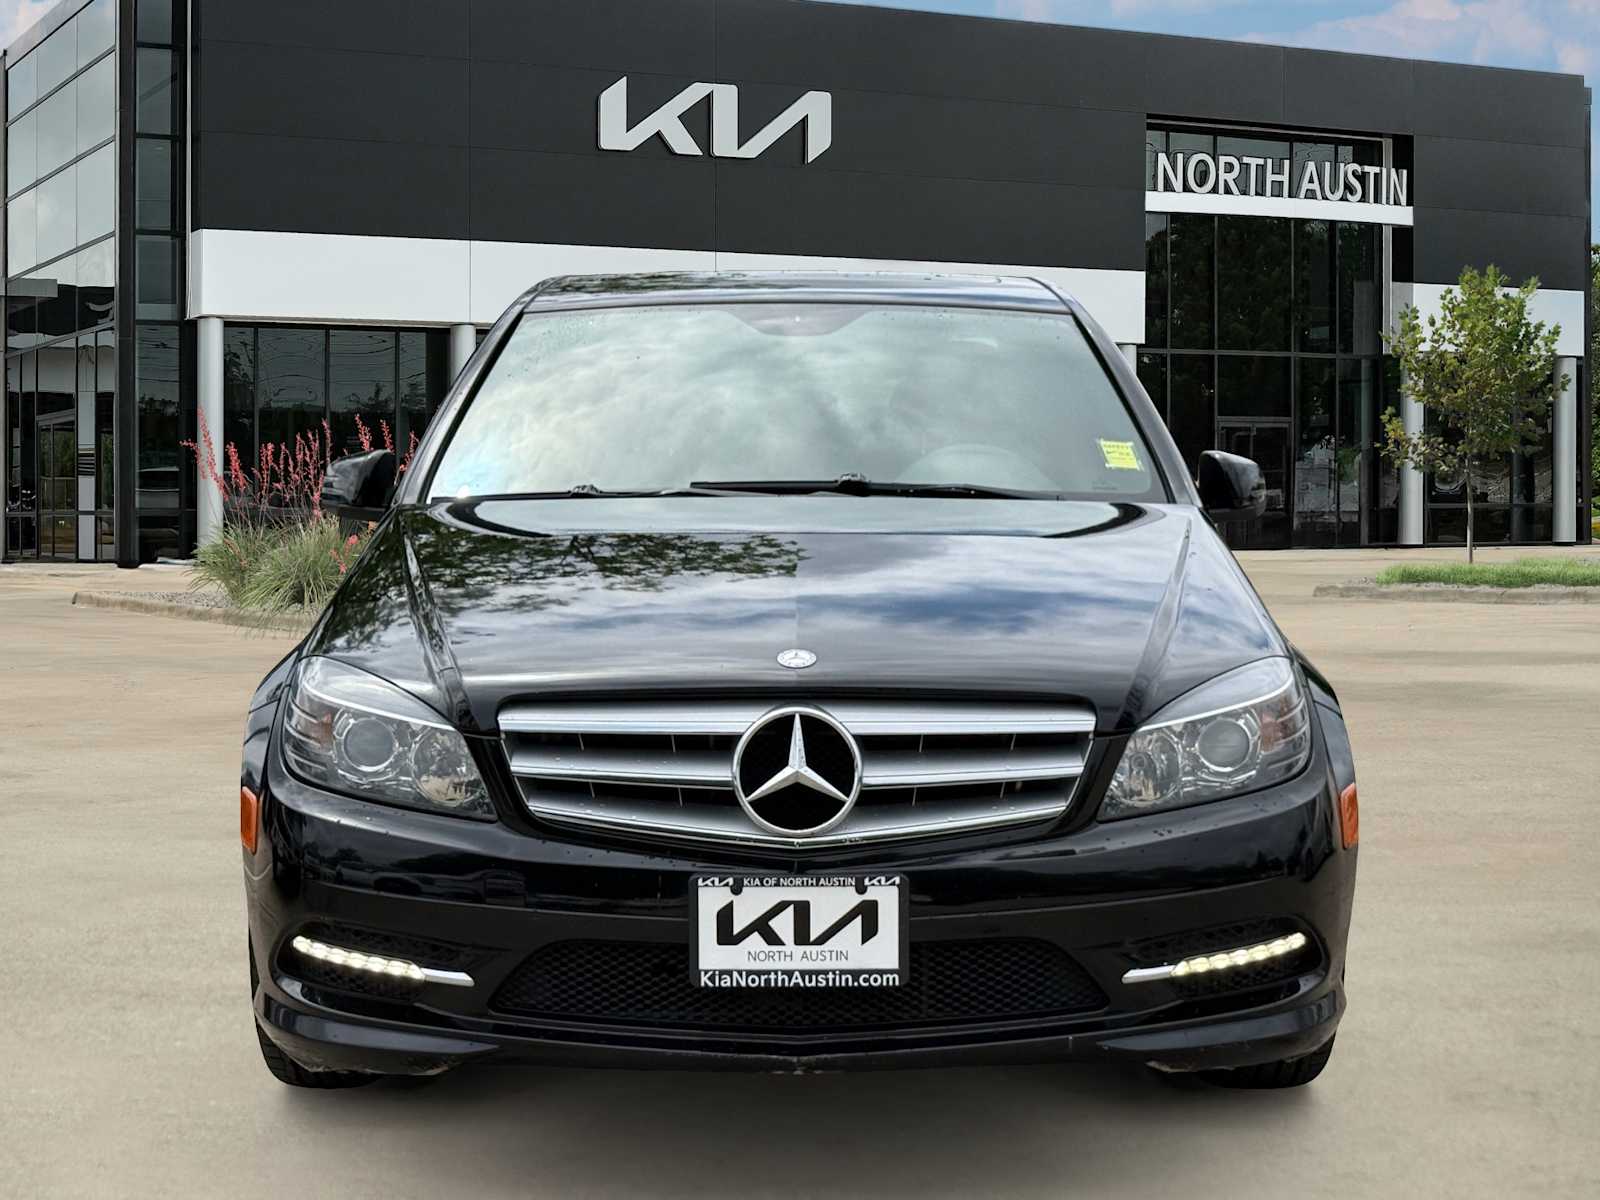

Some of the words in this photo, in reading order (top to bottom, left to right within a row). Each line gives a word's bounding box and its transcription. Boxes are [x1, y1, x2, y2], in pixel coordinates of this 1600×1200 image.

[598, 75, 832, 164] KIA
[1157, 152, 1291, 199] NORTH
[1300, 160, 1408, 207] AUSTIN
[743, 877, 760, 887] KIA
[763, 877, 777, 887] OF
[780, 877, 817, 887] NORTH
[819, 877, 856, 887] AUSTIN
[716, 900, 878, 945] KIA
[747, 950, 793, 962] NORTH
[800, 950, 849, 962] AUSTIN
[700, 970, 900, 988] KiaNorthAustin.com
